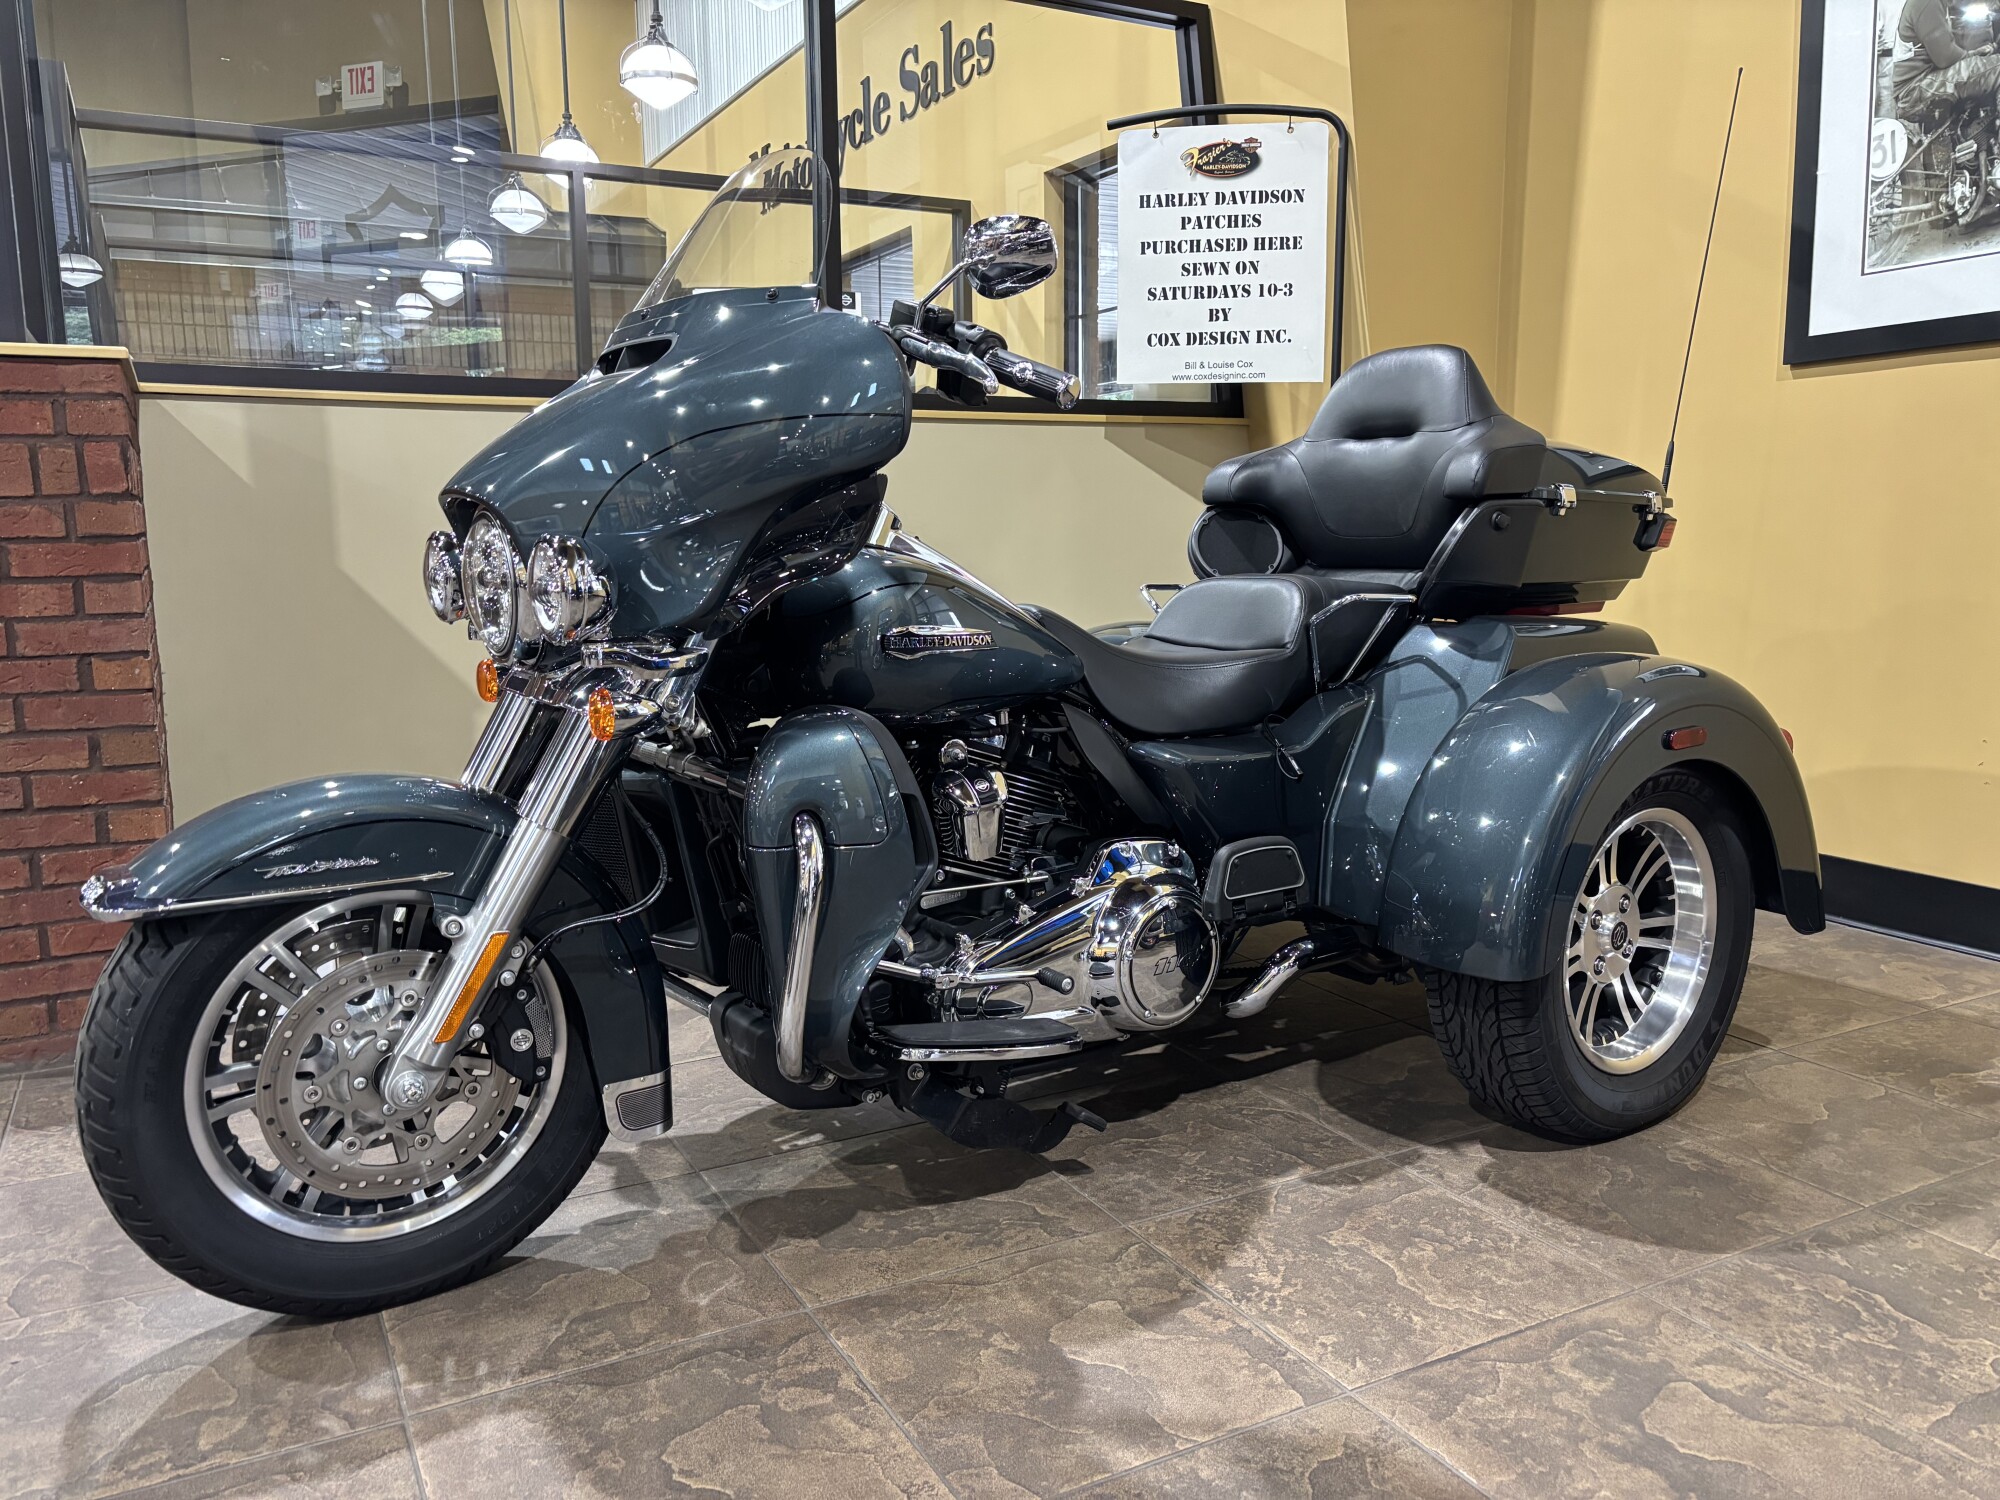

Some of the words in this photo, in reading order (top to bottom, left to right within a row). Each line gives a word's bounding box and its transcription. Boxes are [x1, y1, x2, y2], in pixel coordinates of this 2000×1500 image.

[900, 20, 995, 122] Sales
[1180, 137, 1233, 176] Frazier's
[1871, 129, 1897, 169] 31
[1139, 192, 1209, 209] HARLEY
[1214, 188, 1306, 206] DAVIDSON
[1180, 213, 1262, 230] PATCHES
[1140, 237, 1248, 255] PURCHASED
[1253, 235, 1303, 251] HERE
[1180, 261, 1231, 277] SEWN
[1235, 260, 1260, 275] ON
[1147, 283, 1252, 301] SATURDAYS
[1258, 282, 1294, 298] 10-3
[1208, 307, 1232, 322] BY
[1146, 332, 1181, 347] COX
[1185, 330, 1251, 346] DESIGN
[1255, 328, 1292, 344] INC.
[1184, 361, 1198, 370] Bill
[1199, 360, 1206, 369] &
[1207, 359, 1235, 369] Louise
[1236, 359, 1254, 368] Cox
[1171, 371, 1267, 382] www.coxdesigninc.com
[888, 634, 993, 650] HARLEY-DAVIDSON
